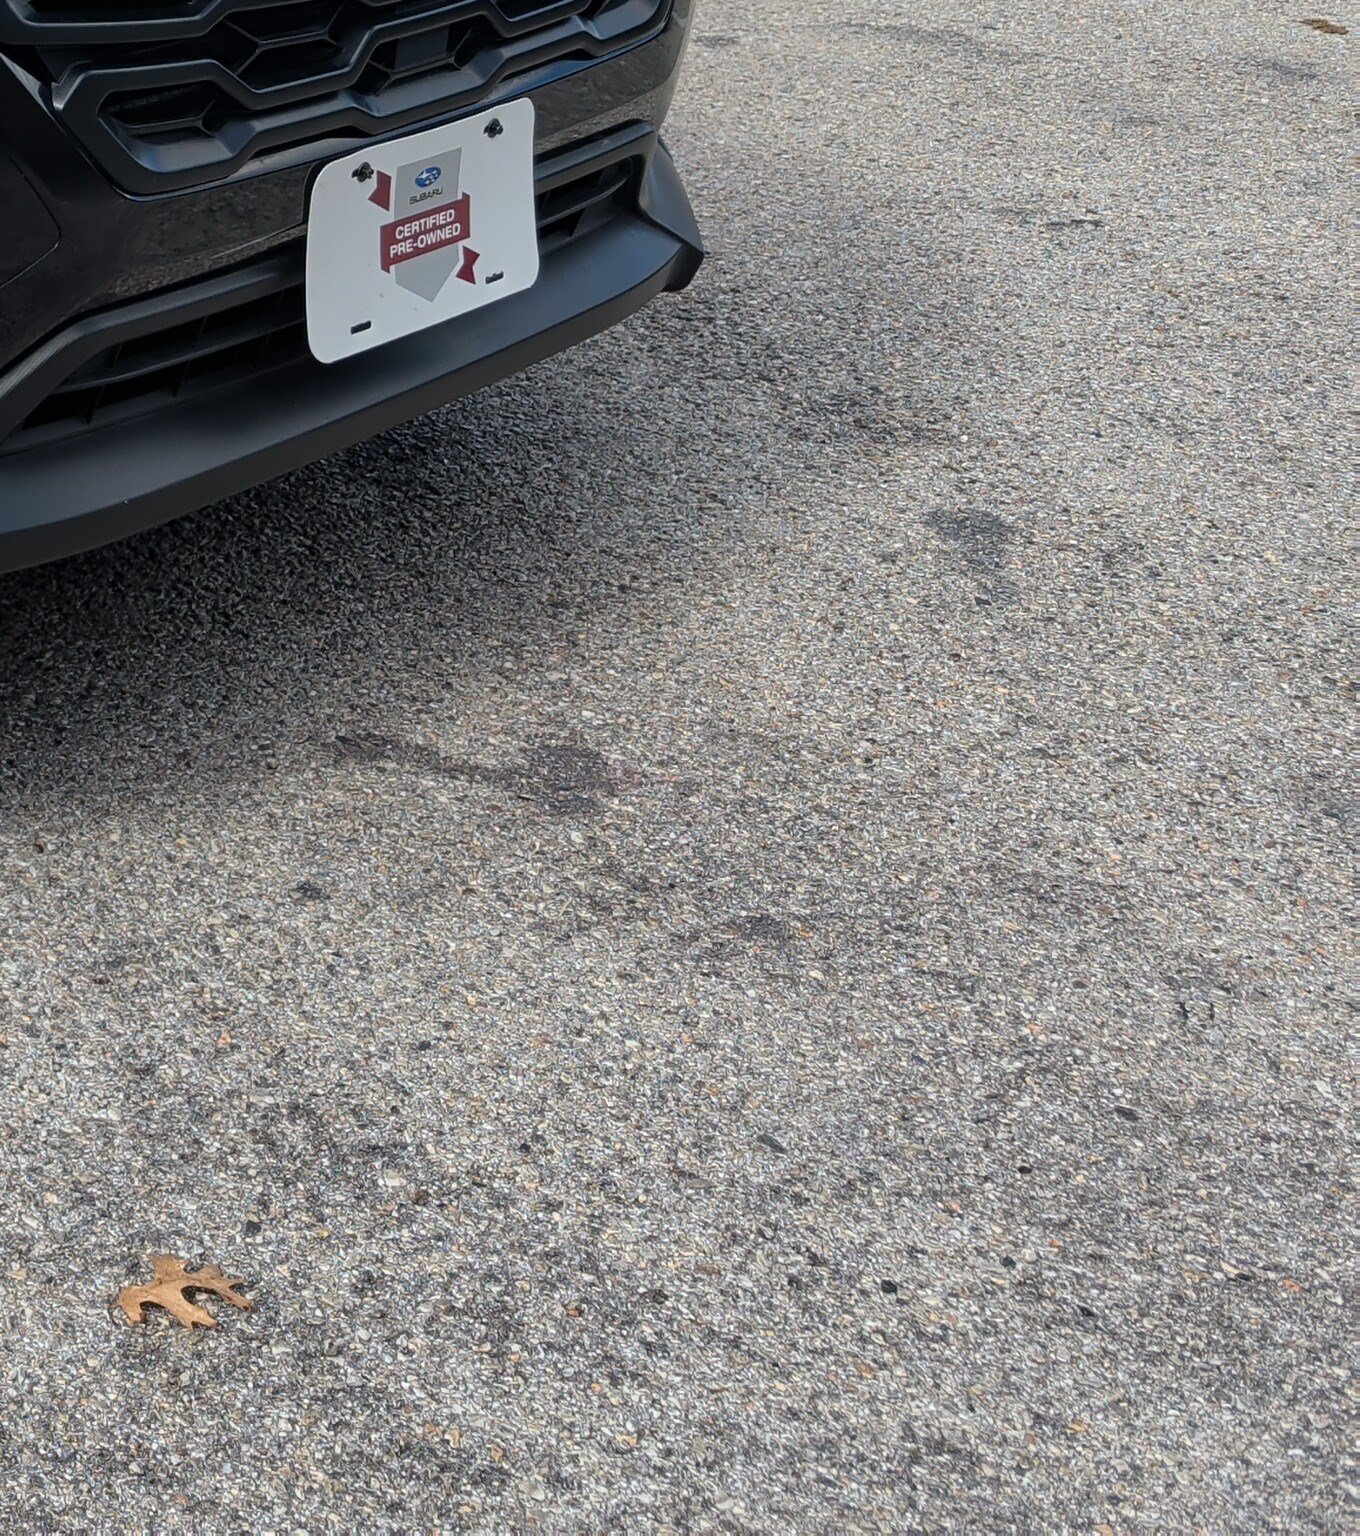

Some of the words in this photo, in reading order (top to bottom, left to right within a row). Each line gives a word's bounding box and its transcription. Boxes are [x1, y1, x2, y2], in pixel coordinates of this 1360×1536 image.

[409, 186, 444, 205] SUBARU
[395, 208, 455, 239] CERTIFIED
[389, 222, 461, 259] PRE-OWNED
